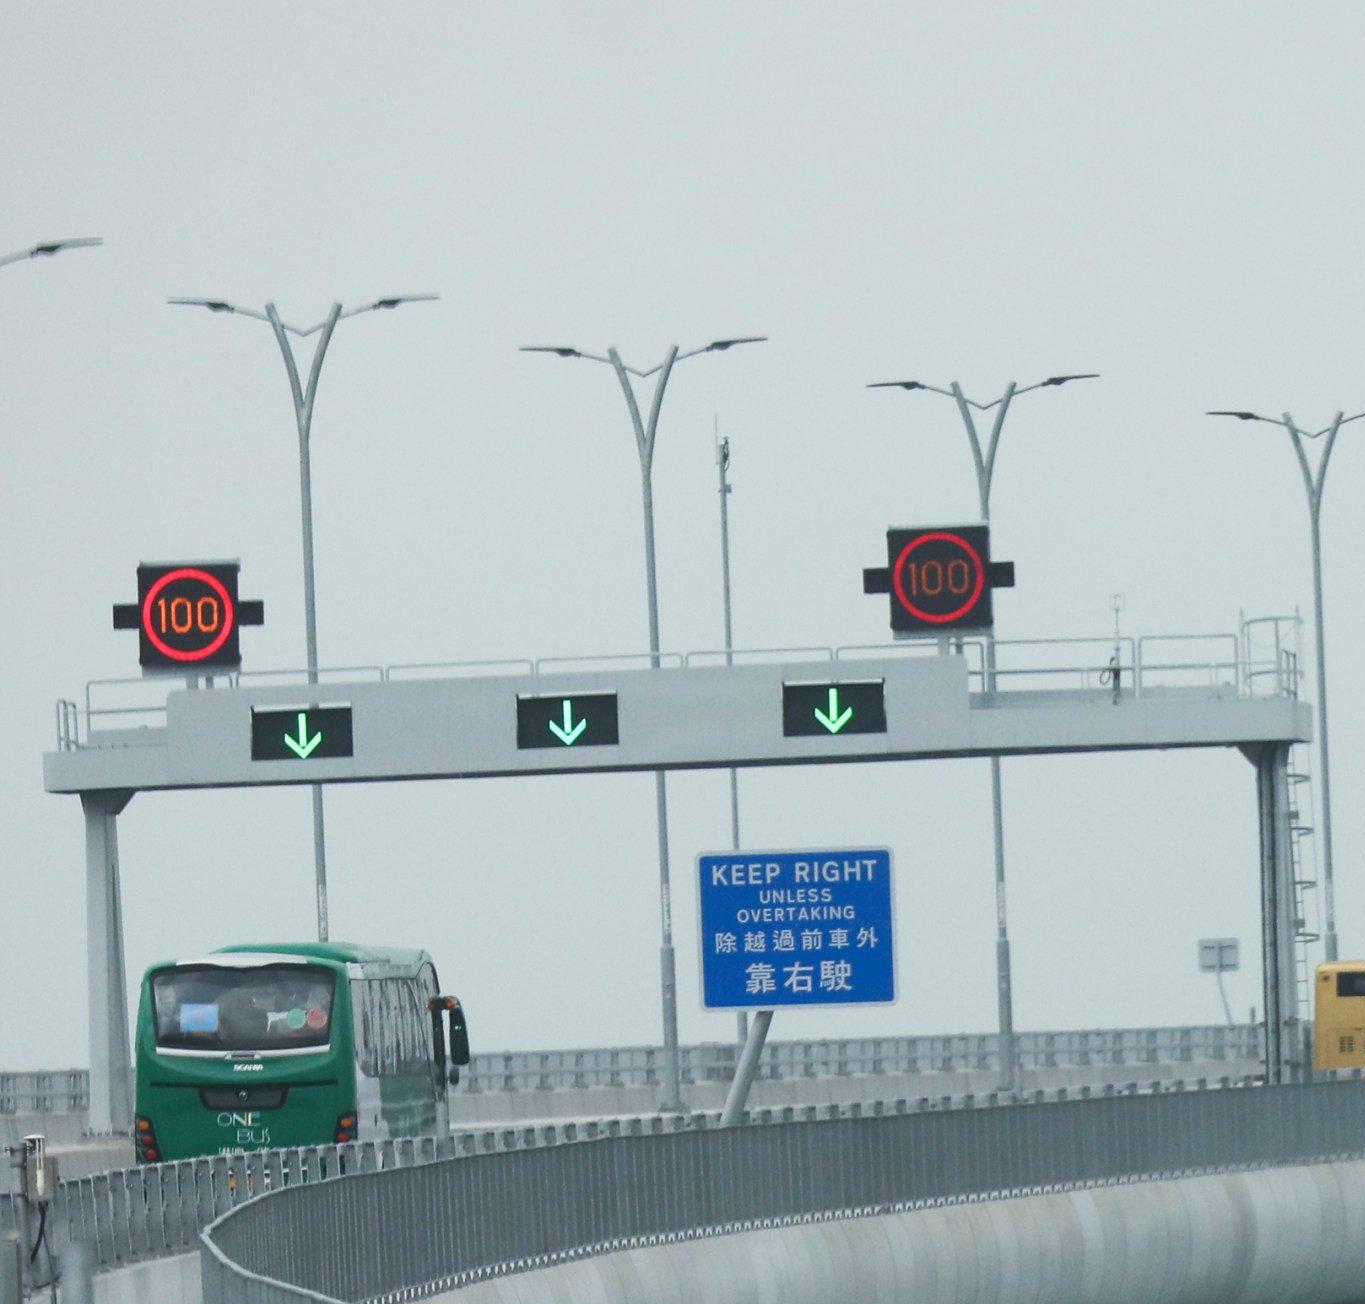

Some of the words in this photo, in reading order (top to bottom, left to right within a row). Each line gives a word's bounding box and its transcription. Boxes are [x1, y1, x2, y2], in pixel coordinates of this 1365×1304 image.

[908, 559, 970, 597] 100
[157, 596, 219, 634] 100
[711, 863, 781, 886] KEEP
[794, 859, 878, 883] RIGHT
[759, 888, 833, 904] UNLESS
[736, 905, 856, 924] OVERTAKING
[714, 926, 879, 955] 除越過前車外
[744, 959, 853, 995] 靠右駛
[233, 1063, 264, 1072] SCANIA
[216, 1112, 261, 1127] ONE
[236, 1127, 271, 1144] BUS
